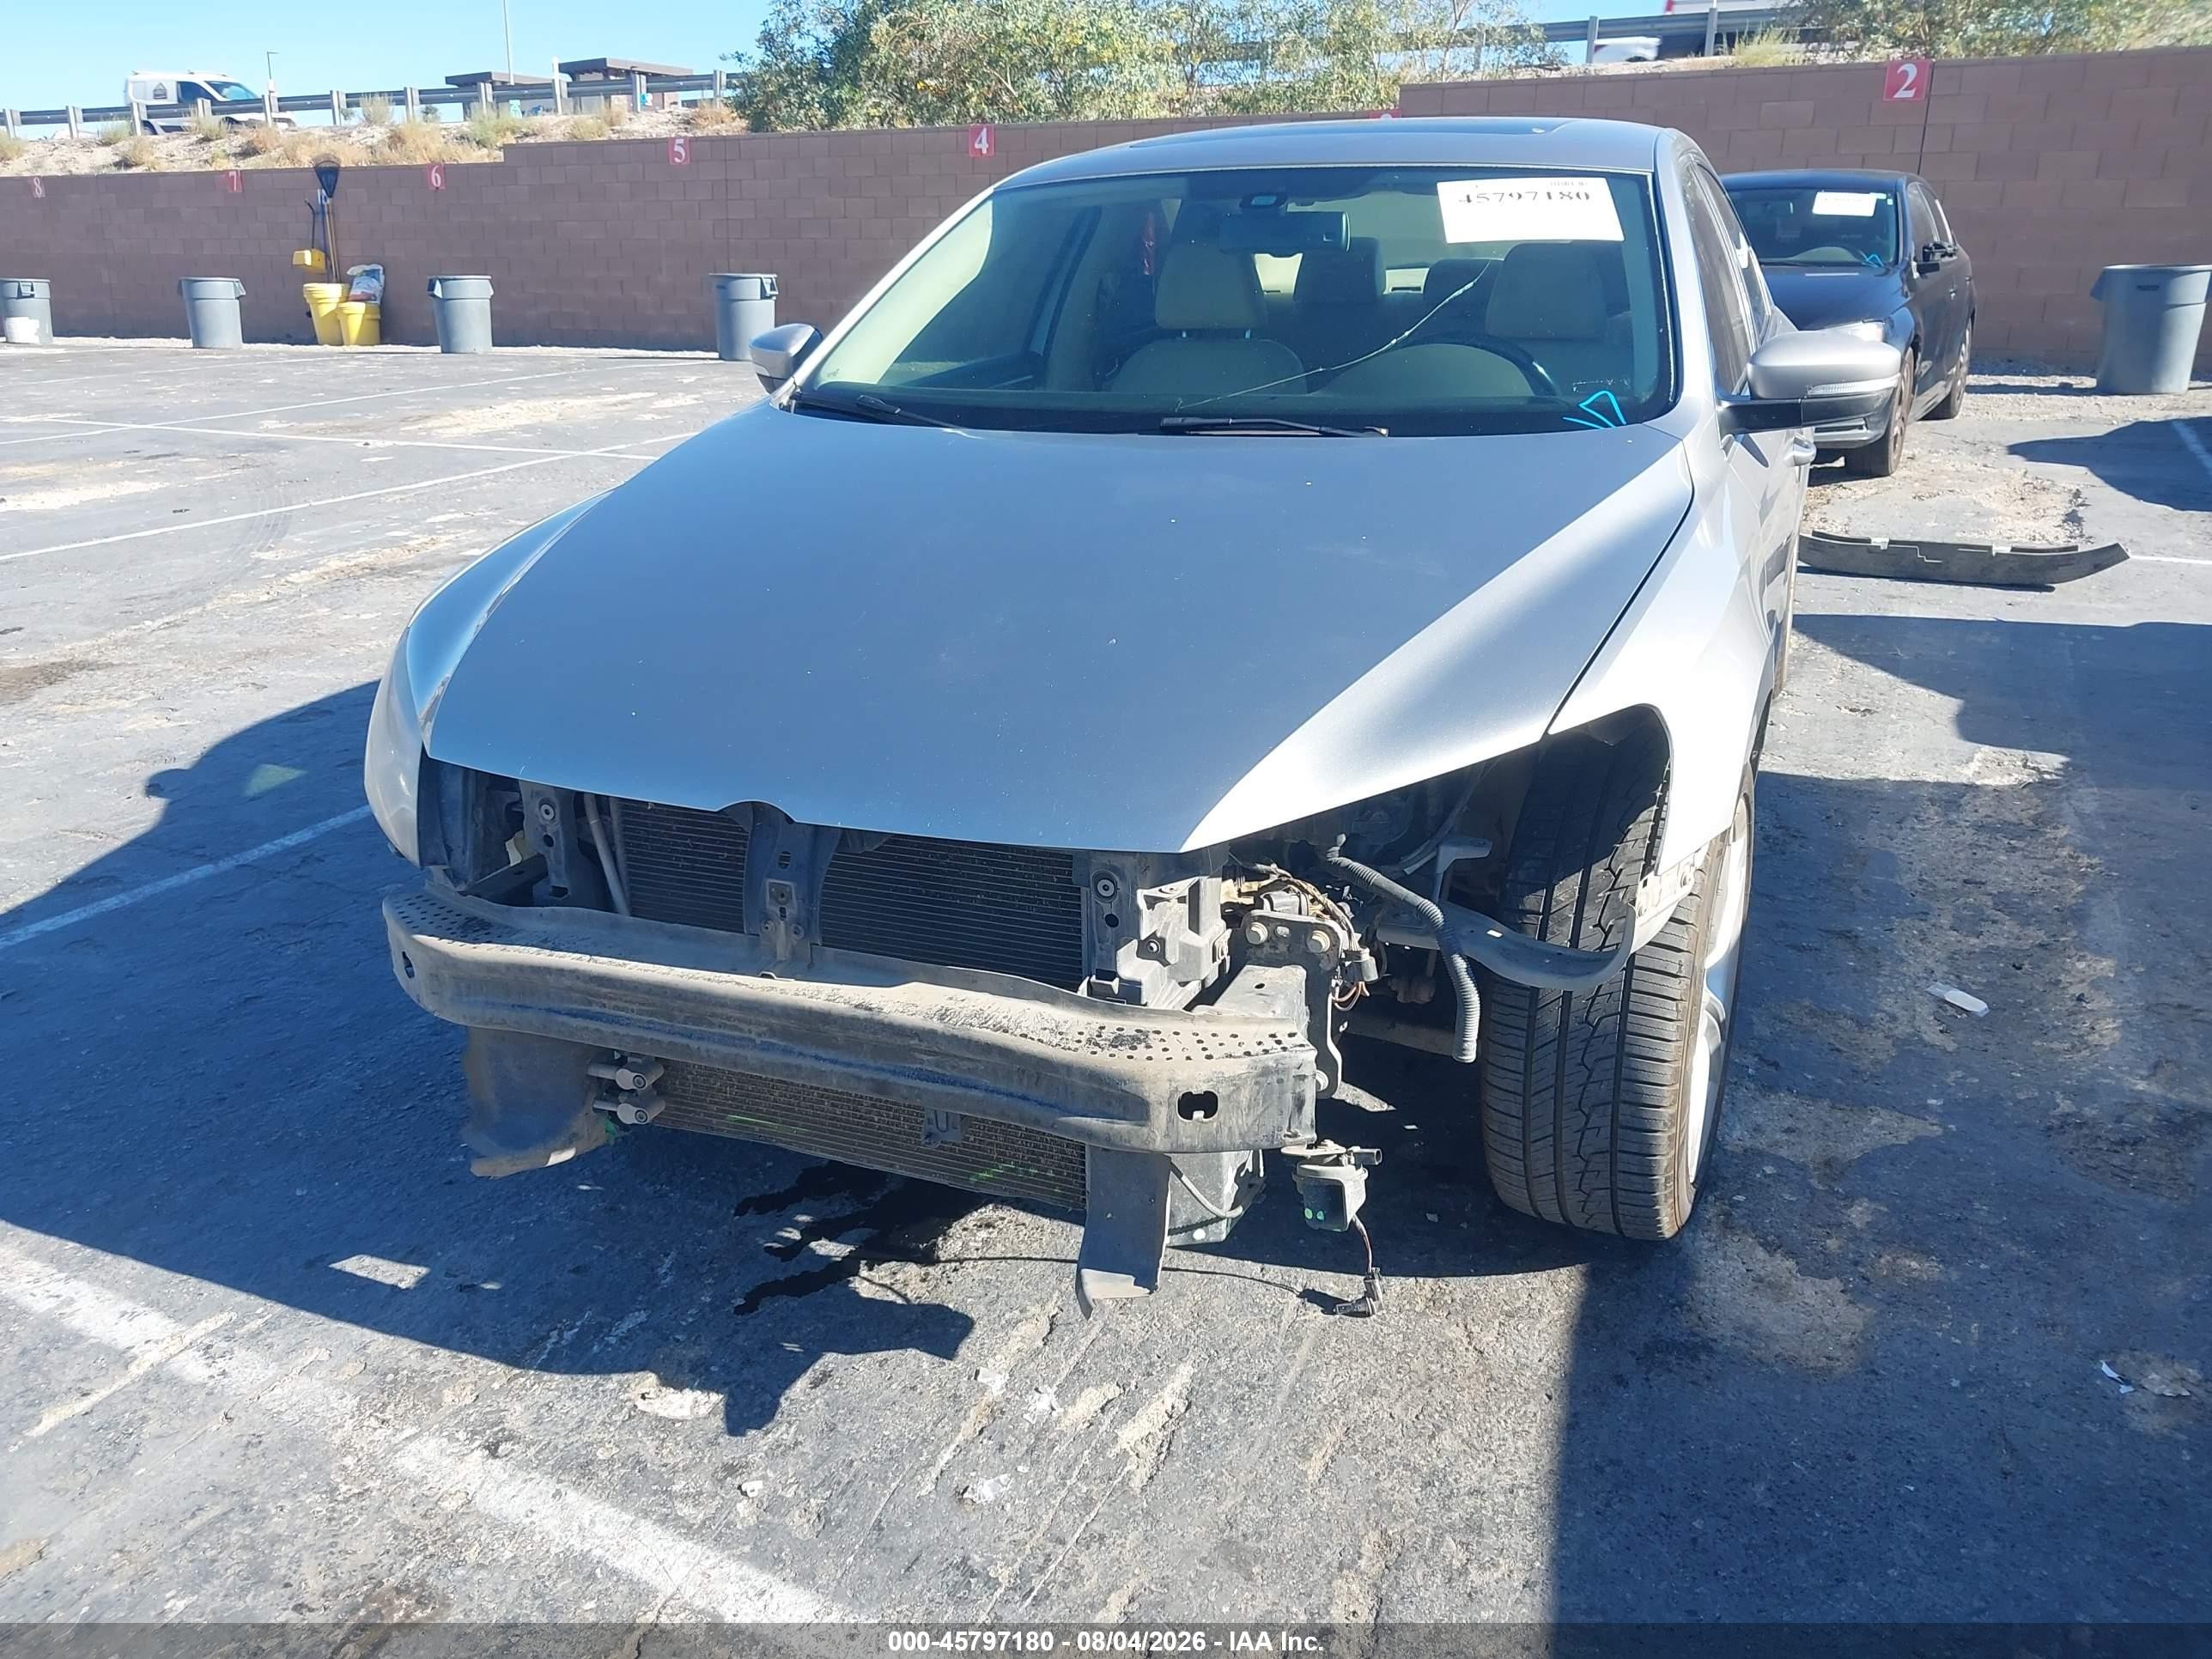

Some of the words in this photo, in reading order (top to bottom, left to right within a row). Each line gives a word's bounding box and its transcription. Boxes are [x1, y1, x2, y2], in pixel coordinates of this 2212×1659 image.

[1893, 63, 1917, 98] 2
[673, 138, 686, 163] 5
[974, 127, 989, 155] 4
[33, 177, 42, 198] 8
[228, 171, 237, 191] 7
[431, 165, 441, 187] 6
